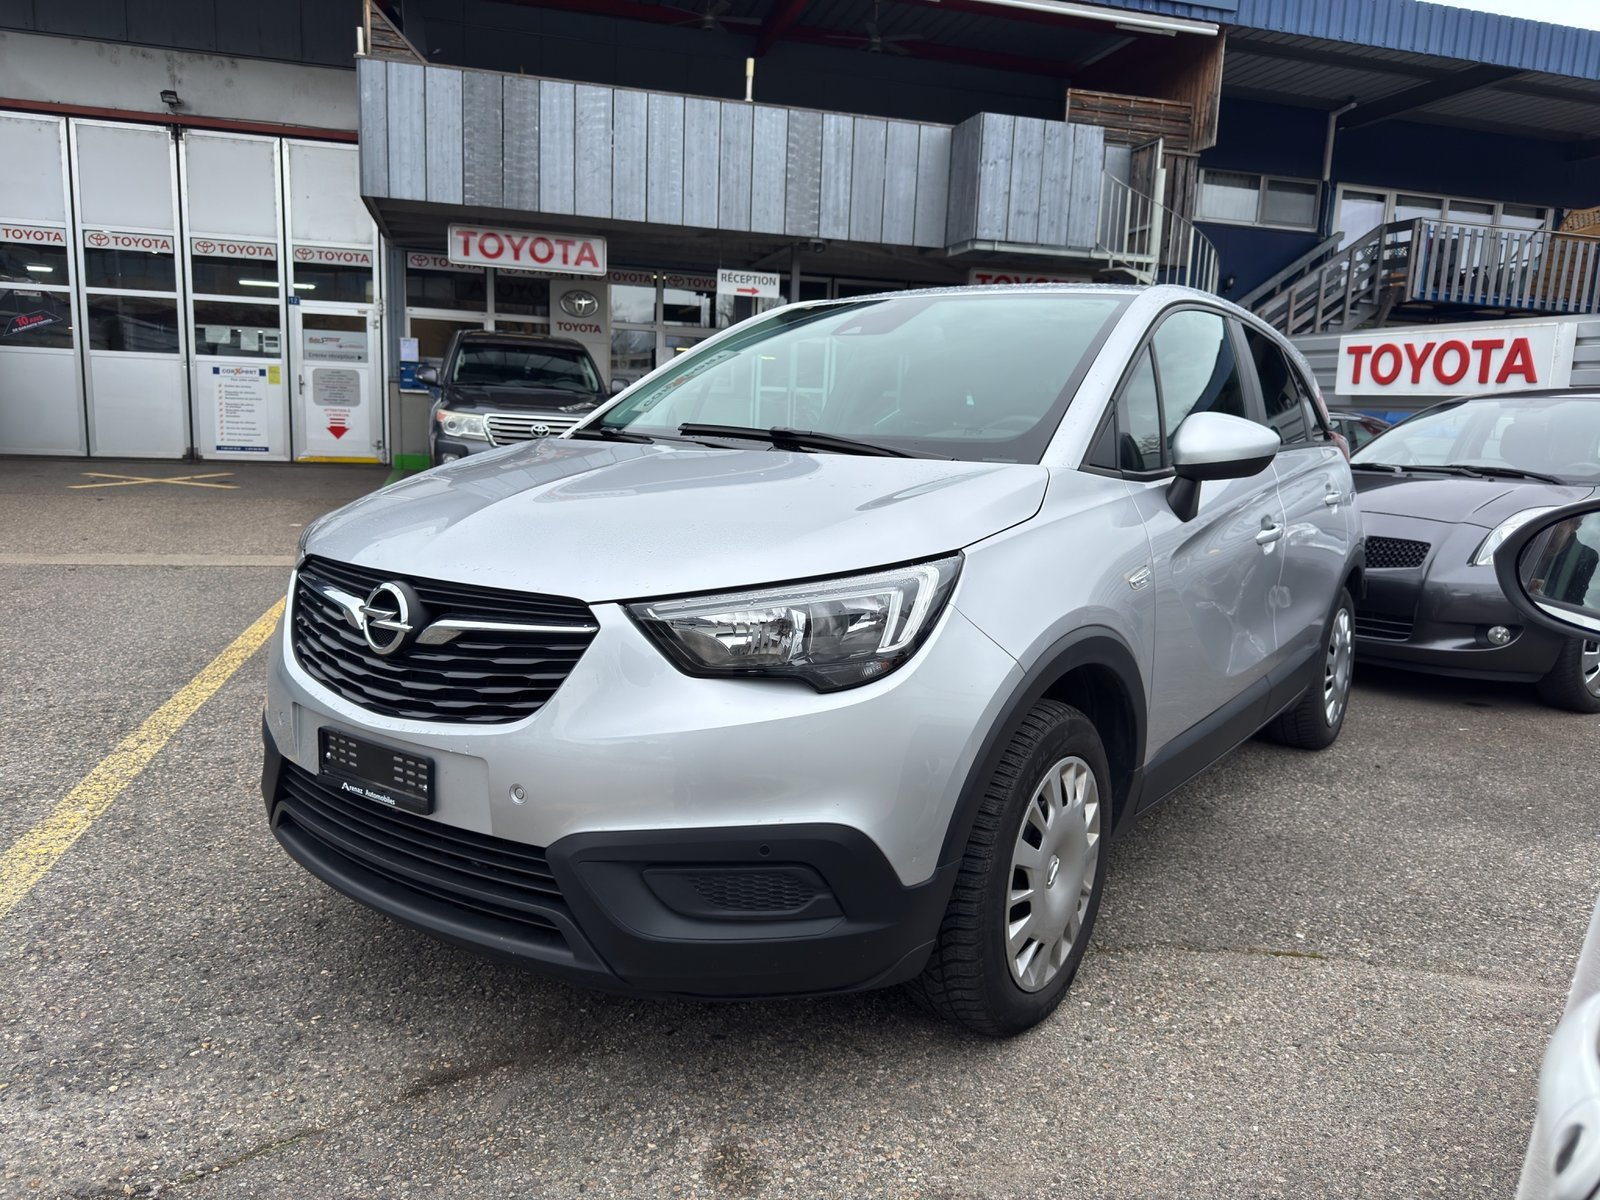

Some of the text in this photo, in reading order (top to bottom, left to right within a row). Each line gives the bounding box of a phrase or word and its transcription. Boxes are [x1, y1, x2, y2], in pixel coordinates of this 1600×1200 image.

[2, 228, 64, 242] TOYOTA
[112, 236, 170, 249] TOYOTA
[455, 230, 600, 268] TOYOTA
[218, 243, 274, 257] TOYOTA
[316, 250, 370, 264] TOYOTA
[607, 271, 651, 285] TOYOTA
[687, 278, 717, 289] TOYO
[721, 272, 777, 286] RÉCEPTION
[557, 321, 602, 334] TOYOTA
[1346, 337, 1538, 386] TOYOTA
[341, 782, 396, 805] Arenaz Automobiles
